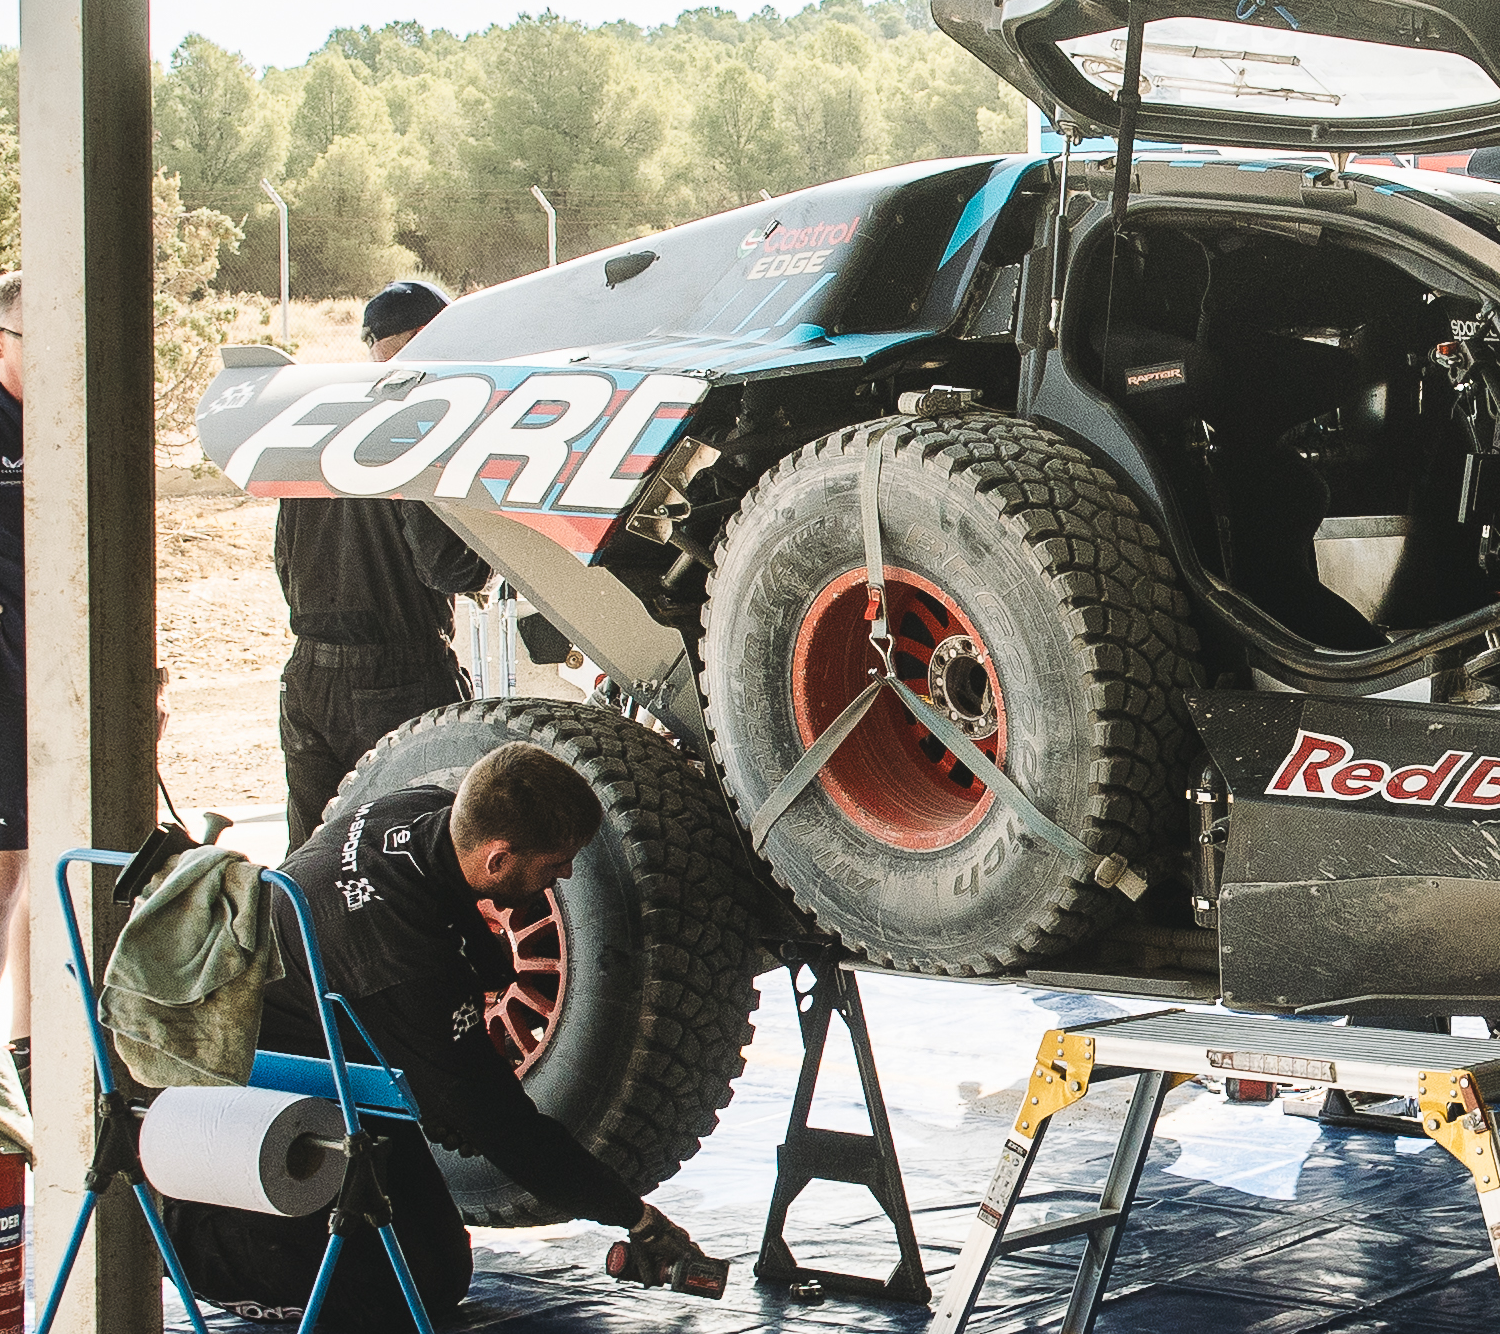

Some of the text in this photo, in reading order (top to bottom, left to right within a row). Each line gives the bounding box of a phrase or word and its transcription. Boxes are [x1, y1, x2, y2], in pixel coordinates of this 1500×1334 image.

[764, 216, 860, 253] Castrol
[747, 249, 835, 280] EDGE
[1127, 368, 1182, 386] RAPTOR
[1268, 731, 1472, 805] Red
